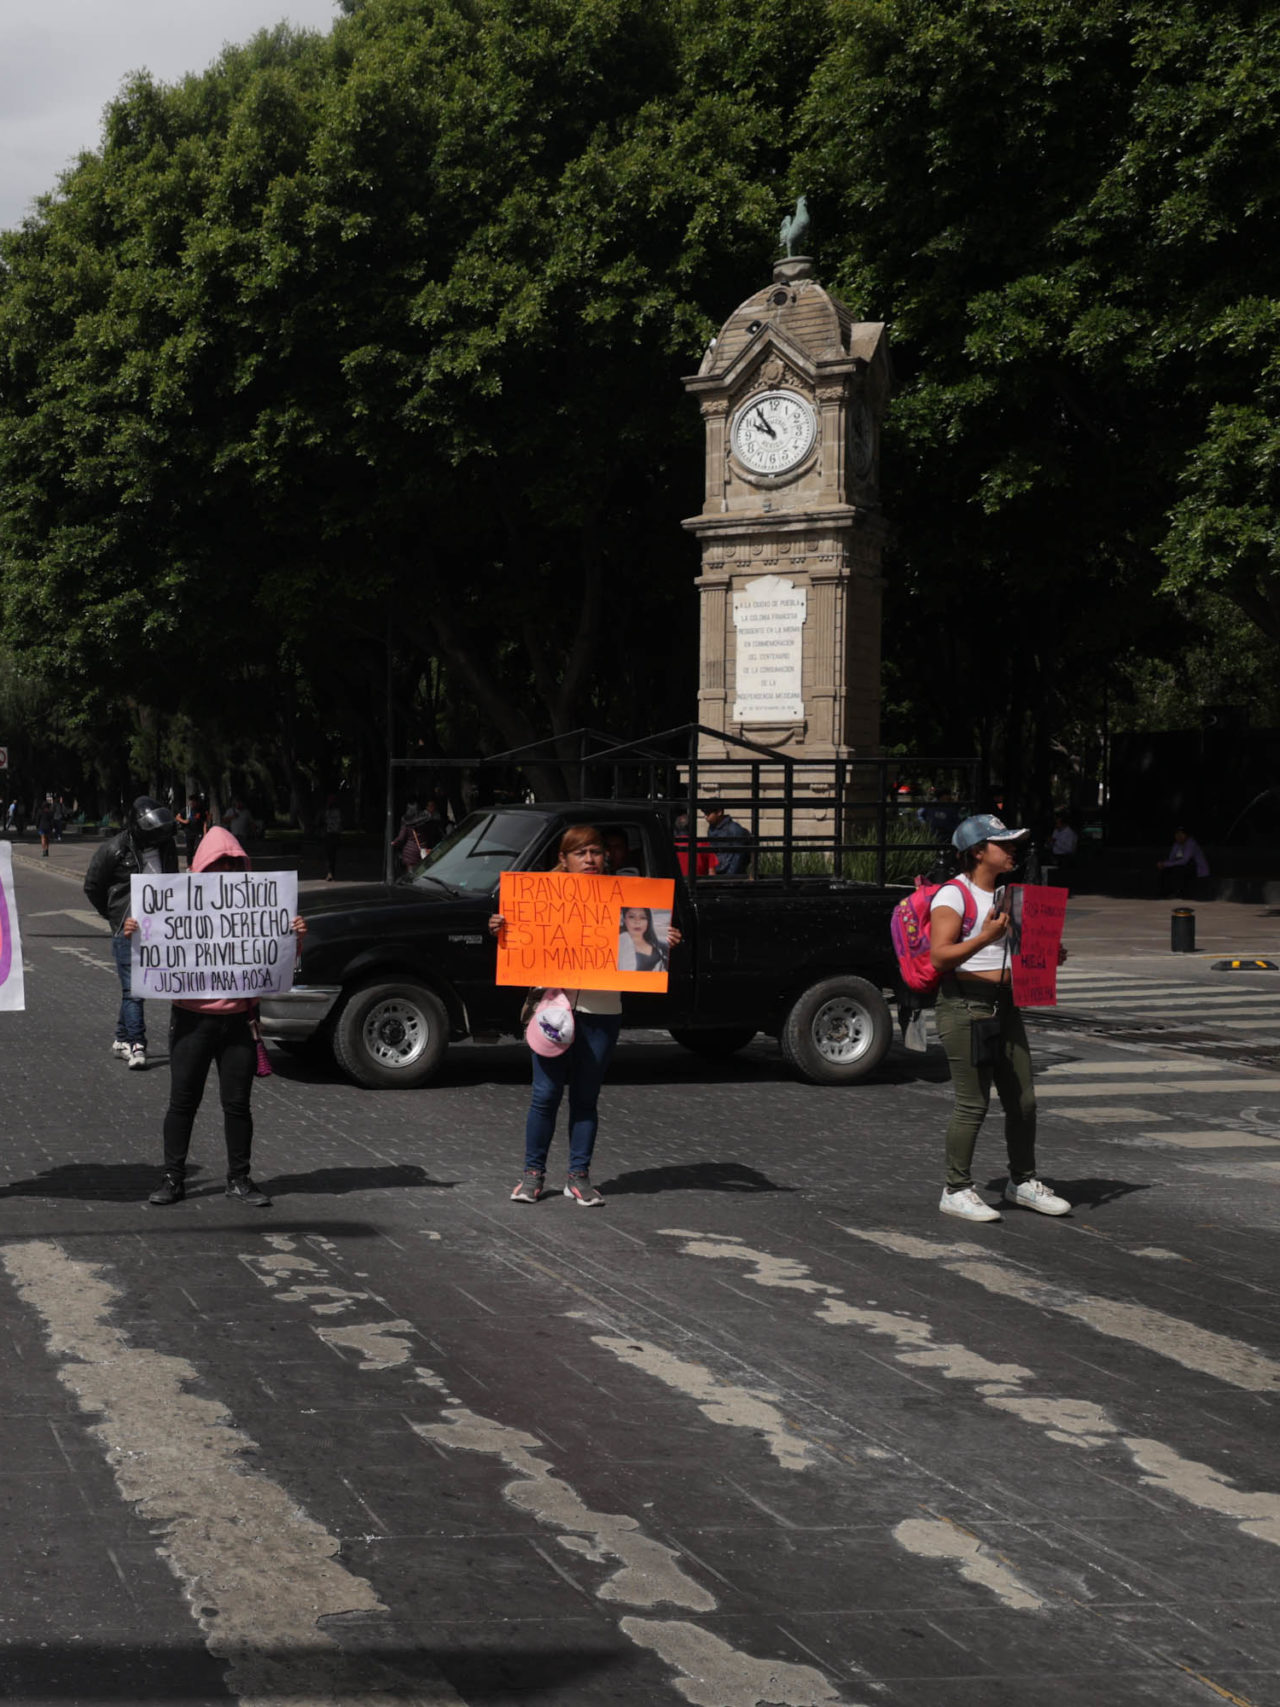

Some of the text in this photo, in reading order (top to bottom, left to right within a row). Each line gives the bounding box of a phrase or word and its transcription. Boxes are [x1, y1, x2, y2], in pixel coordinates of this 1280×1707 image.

[142, 874, 278, 914] Que la Justicia
[505, 874, 624, 904] TRANQUILA
[502, 900, 613, 926] HERMANA
[195, 915, 214, 940] un
[503, 922, 568, 947] ESTA
[581, 924, 610, 950] ES
[140, 939, 278, 968] no un PRIVILEGIO
[504, 946, 618, 972] TU MANADA
[210, 970, 238, 991] PARA
[242, 968, 272, 991] ROSA
